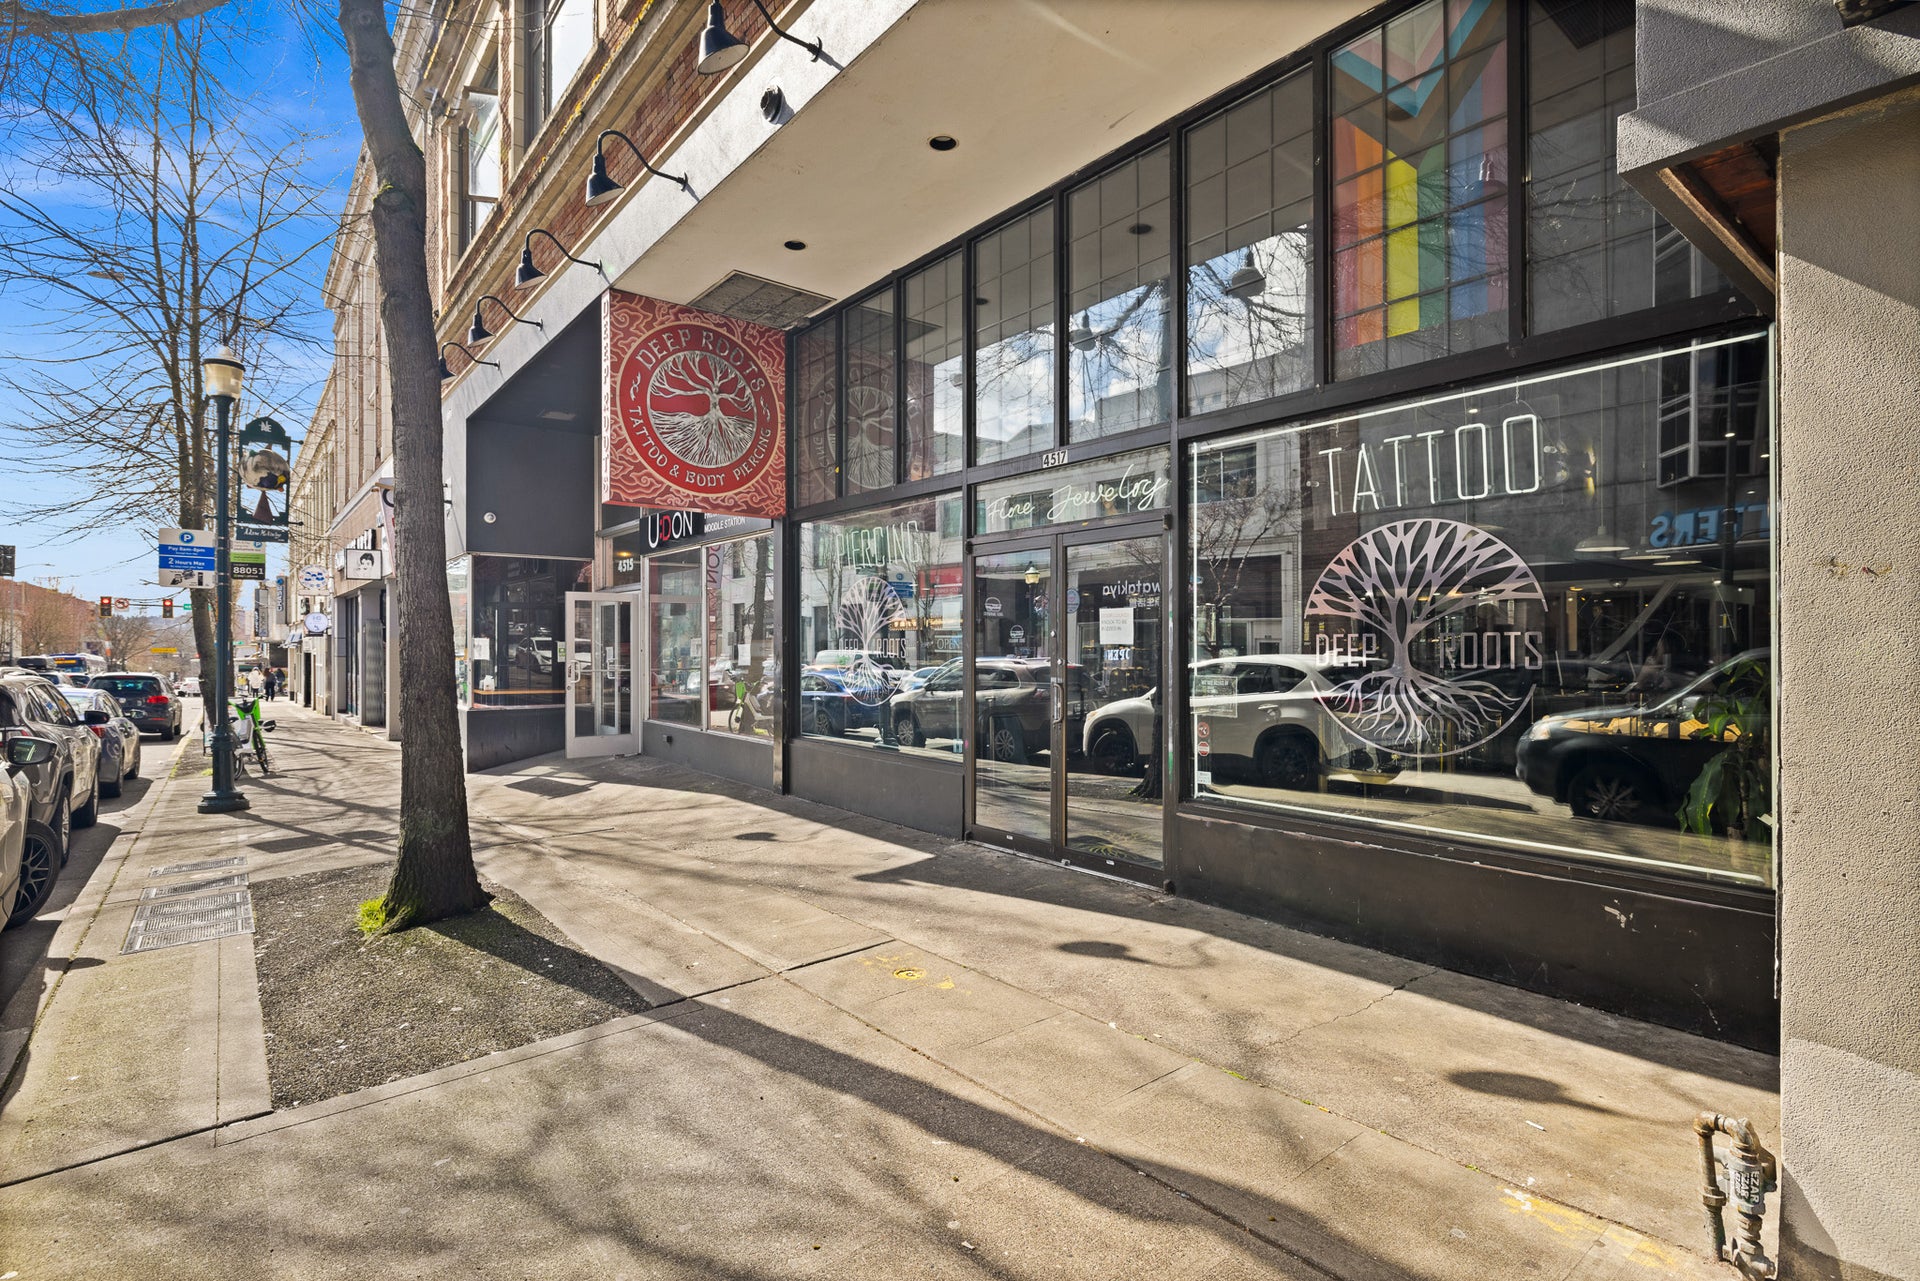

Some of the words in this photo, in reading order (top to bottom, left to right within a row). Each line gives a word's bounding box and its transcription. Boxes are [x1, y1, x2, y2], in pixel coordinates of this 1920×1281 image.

[636, 329, 692, 370] DEEP
[702, 330, 766, 392] ROOTS
[629, 406, 668, 468] TATTOO
[669, 464, 680, 478] &
[685, 469, 726, 487] BODY
[732, 427, 772, 481] PIERCING
[1043, 451, 1067, 467] 4517
[1319, 413, 1541, 517] TATTOO
[987, 496, 1036, 524] Fine
[704, 520, 724, 534] NOODLE
[724, 516, 746, 529] STATION
[836, 520, 922, 570] PIERCING
[168, 557, 174, 565] 2
[233, 566, 264, 575] 88051
[617, 558, 634, 573] 4515
[839, 638, 859, 657] DEEP
[876, 637, 907, 658] ROOTS
[1315, 632, 1377, 669] DEEP
[1438, 630, 1543, 669] ROOTS
